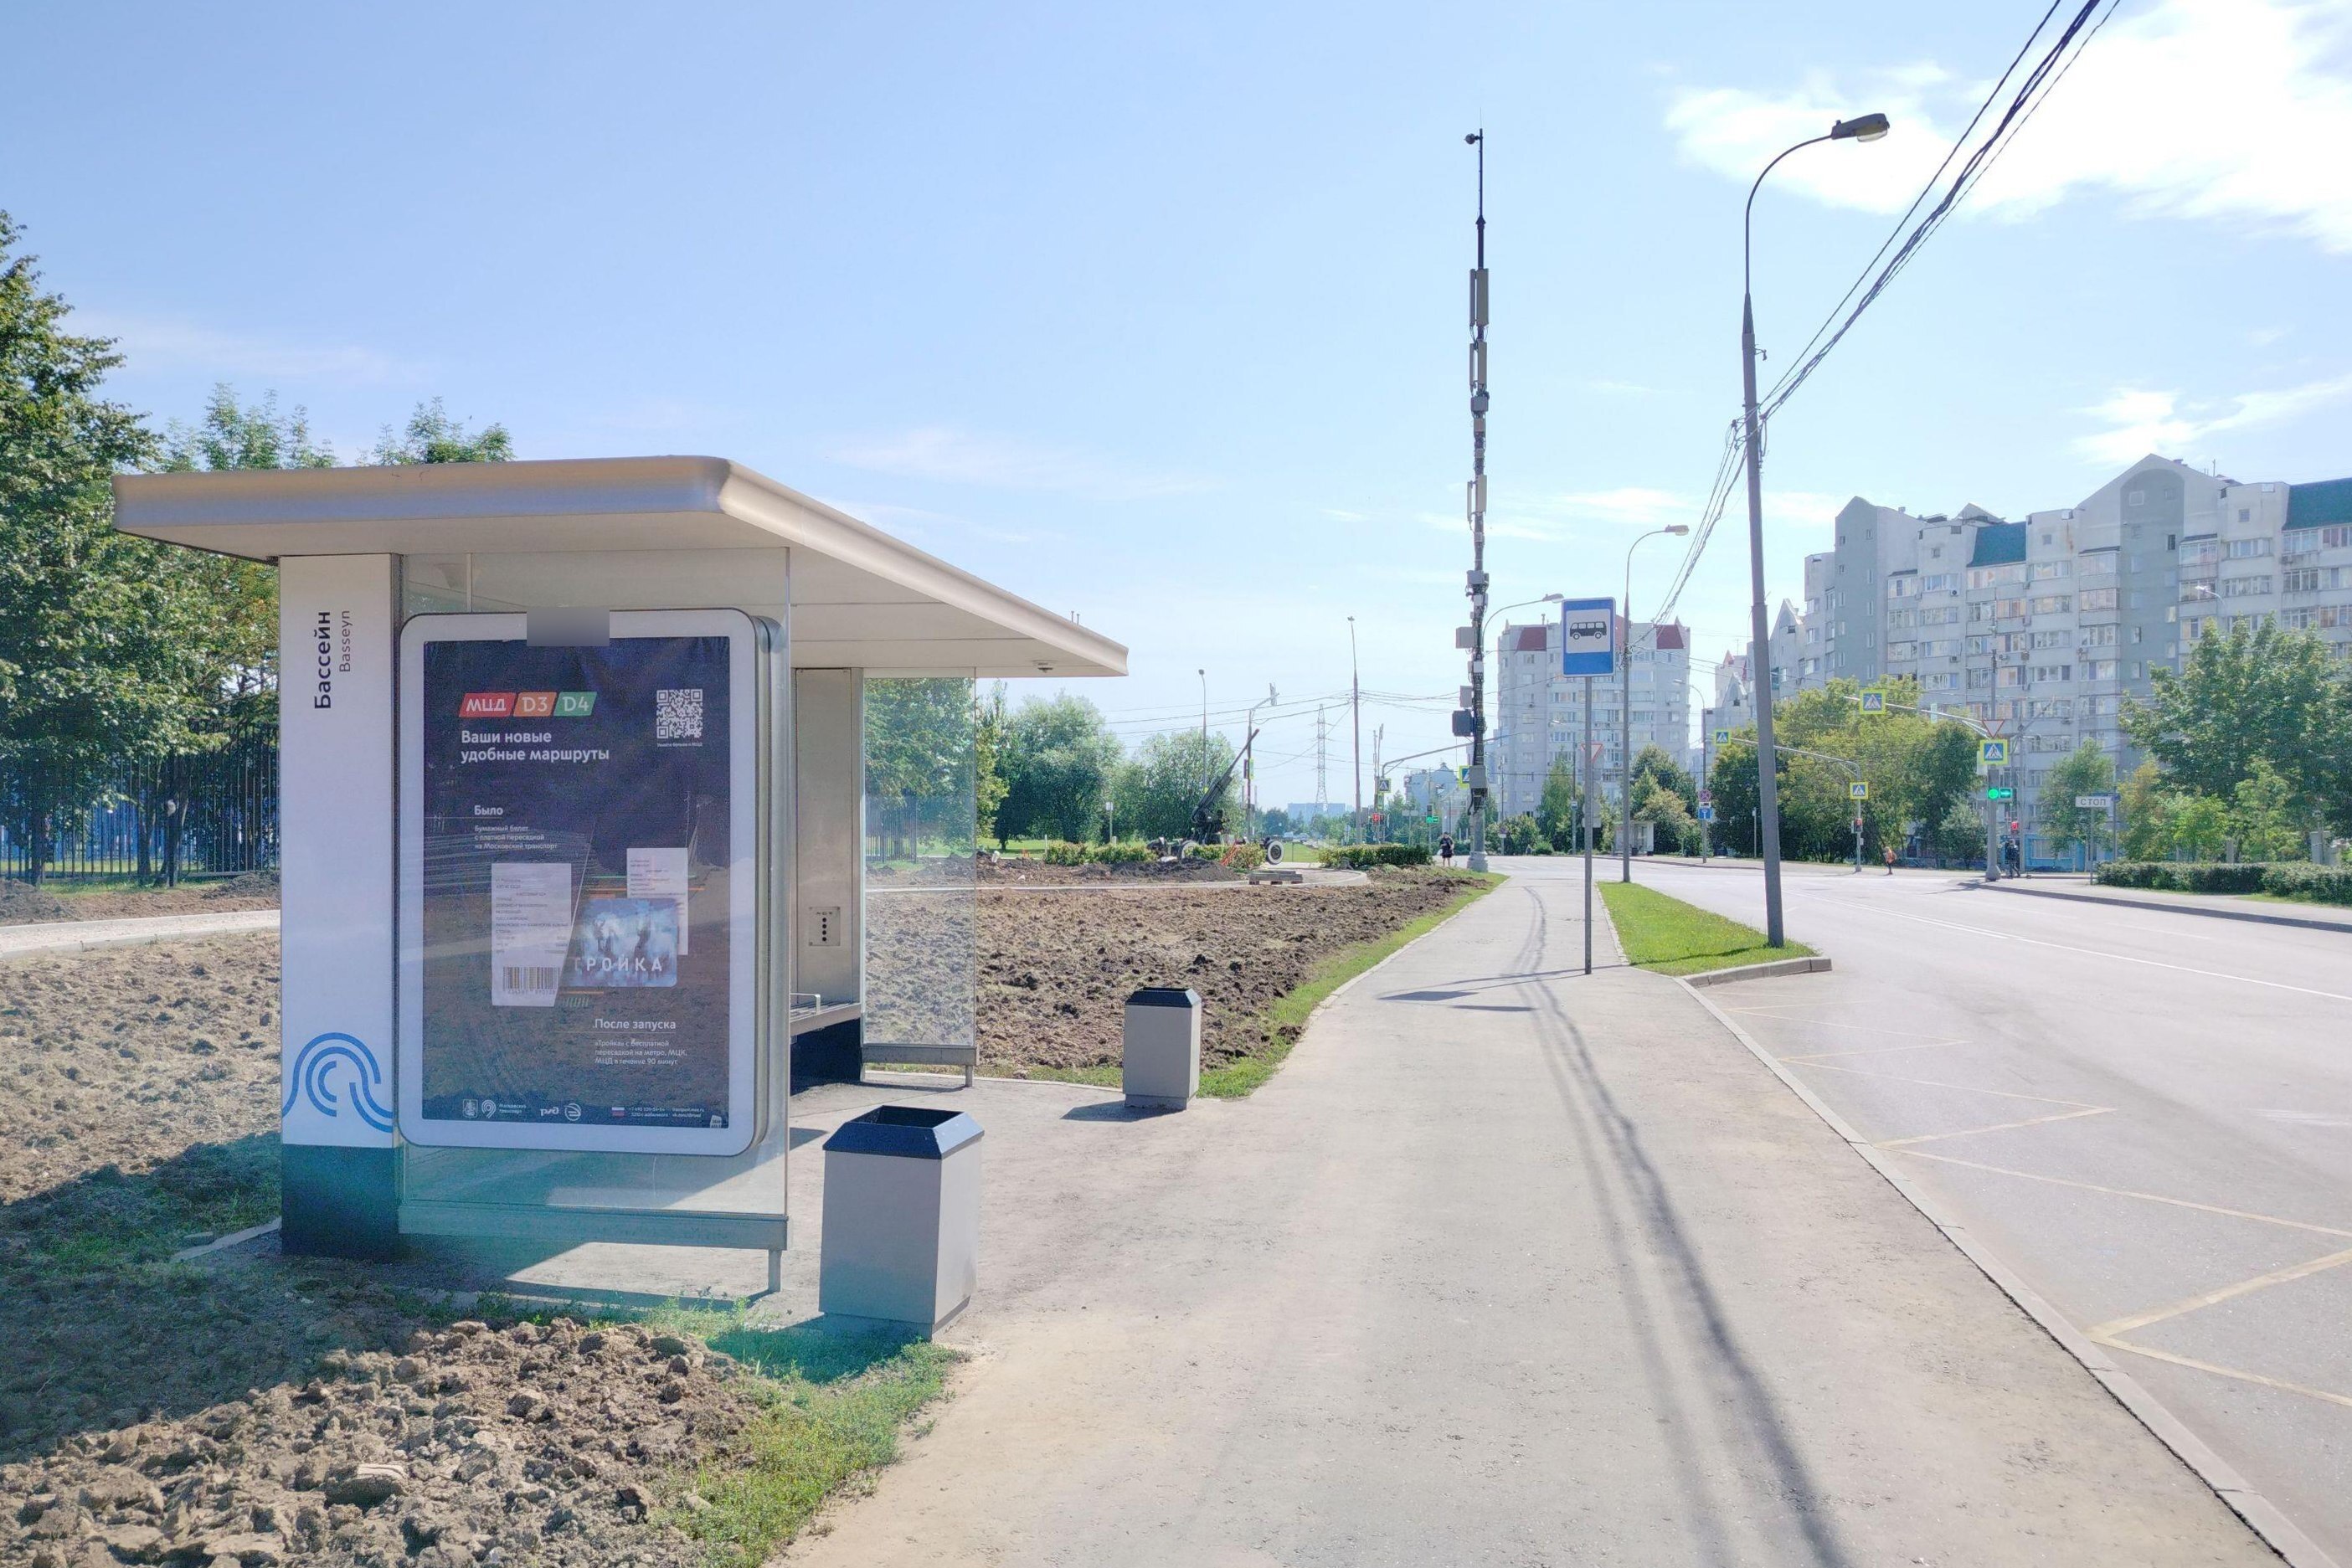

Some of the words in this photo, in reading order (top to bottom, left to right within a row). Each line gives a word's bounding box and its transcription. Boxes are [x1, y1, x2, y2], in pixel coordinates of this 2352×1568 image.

[339, 609, 353, 672] Basseyn
[314, 611, 331, 709] Бассейн
[466, 698, 507, 712] МЦД
[522, 697, 548, 712] D3
[562, 697, 589, 712] D4
[461, 730, 501, 743] Ваши
[505, 732, 552, 743] новые
[461, 748, 526, 763] удобные
[529, 749, 610, 763] маршруты
[2080, 798, 2107, 806] СТОП
[474, 805, 504, 815] Было
[474, 825, 508, 833] Бумажный
[574, 954, 662, 972] ТРОЙКА
[594, 1018, 630, 1029] После
[632, 1020, 677, 1031] запуска
[594, 1057, 614, 1066] МЦД
